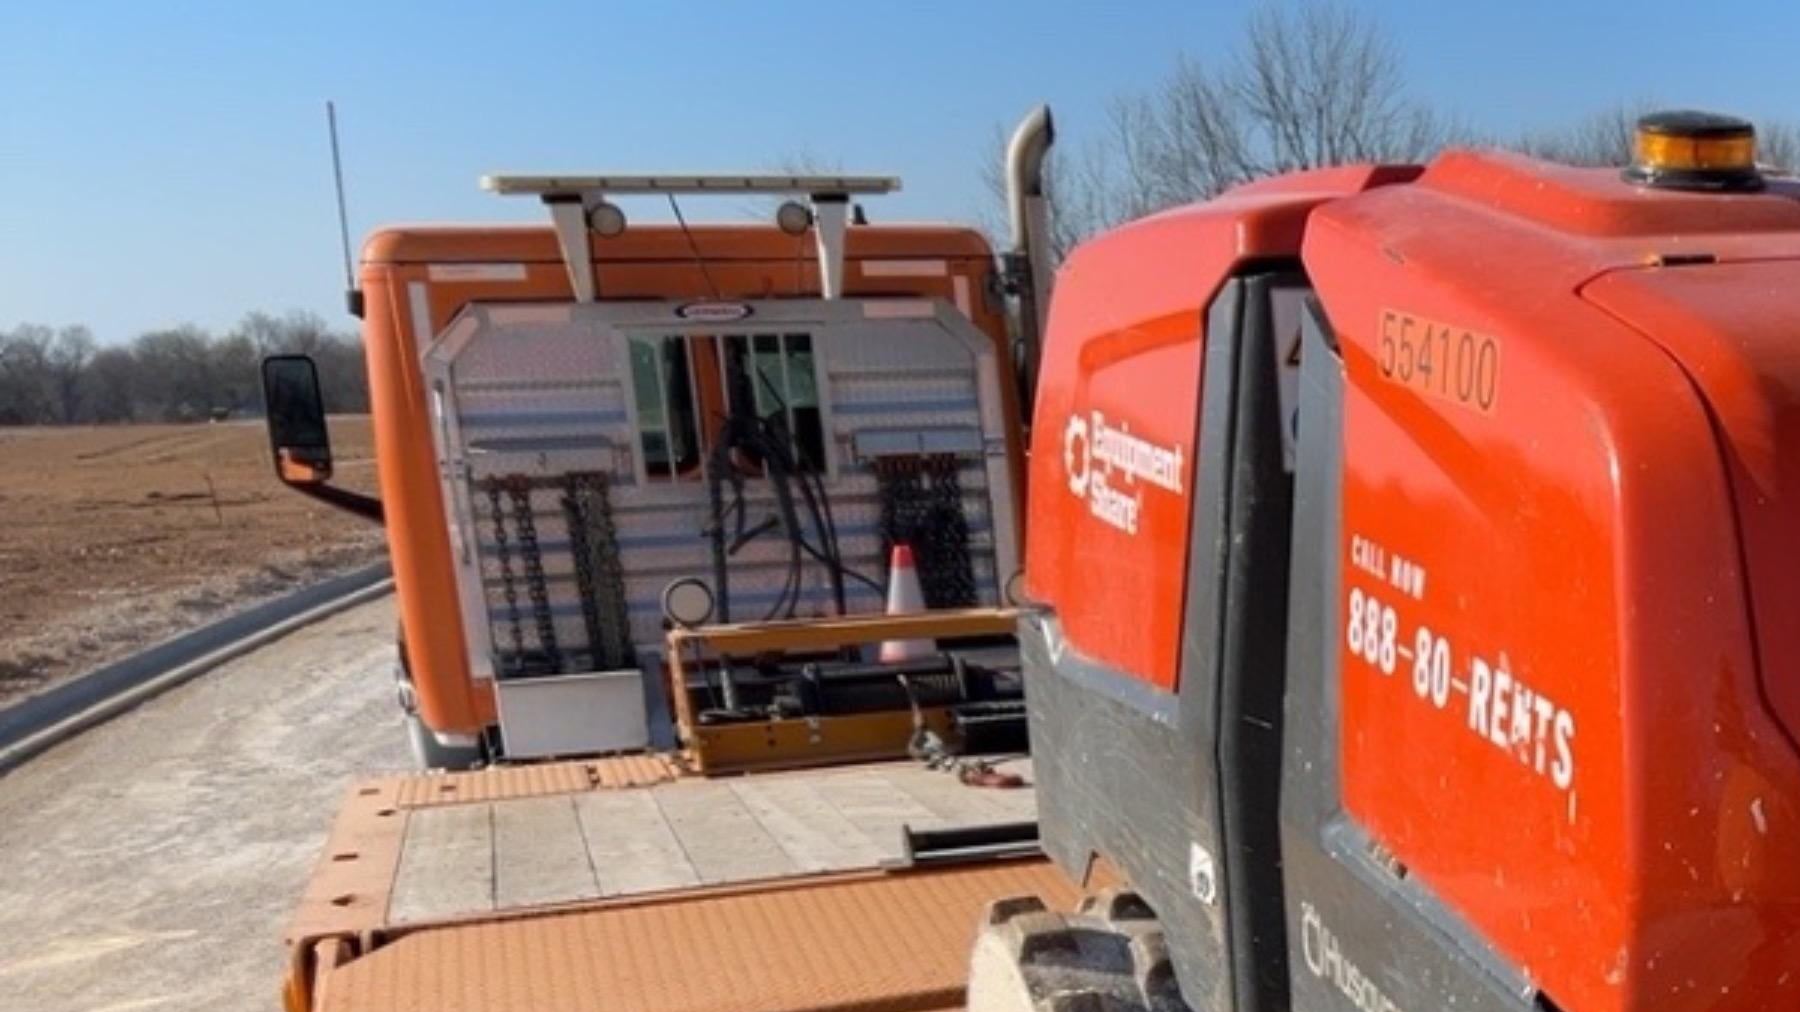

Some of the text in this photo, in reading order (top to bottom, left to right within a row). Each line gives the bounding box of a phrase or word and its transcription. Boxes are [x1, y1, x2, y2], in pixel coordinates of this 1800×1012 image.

[1381, 311, 1498, 412] 554100
[1352, 534, 1426, 600] CALL NOW
[1348, 587, 1576, 790] 888-80-RENTS
